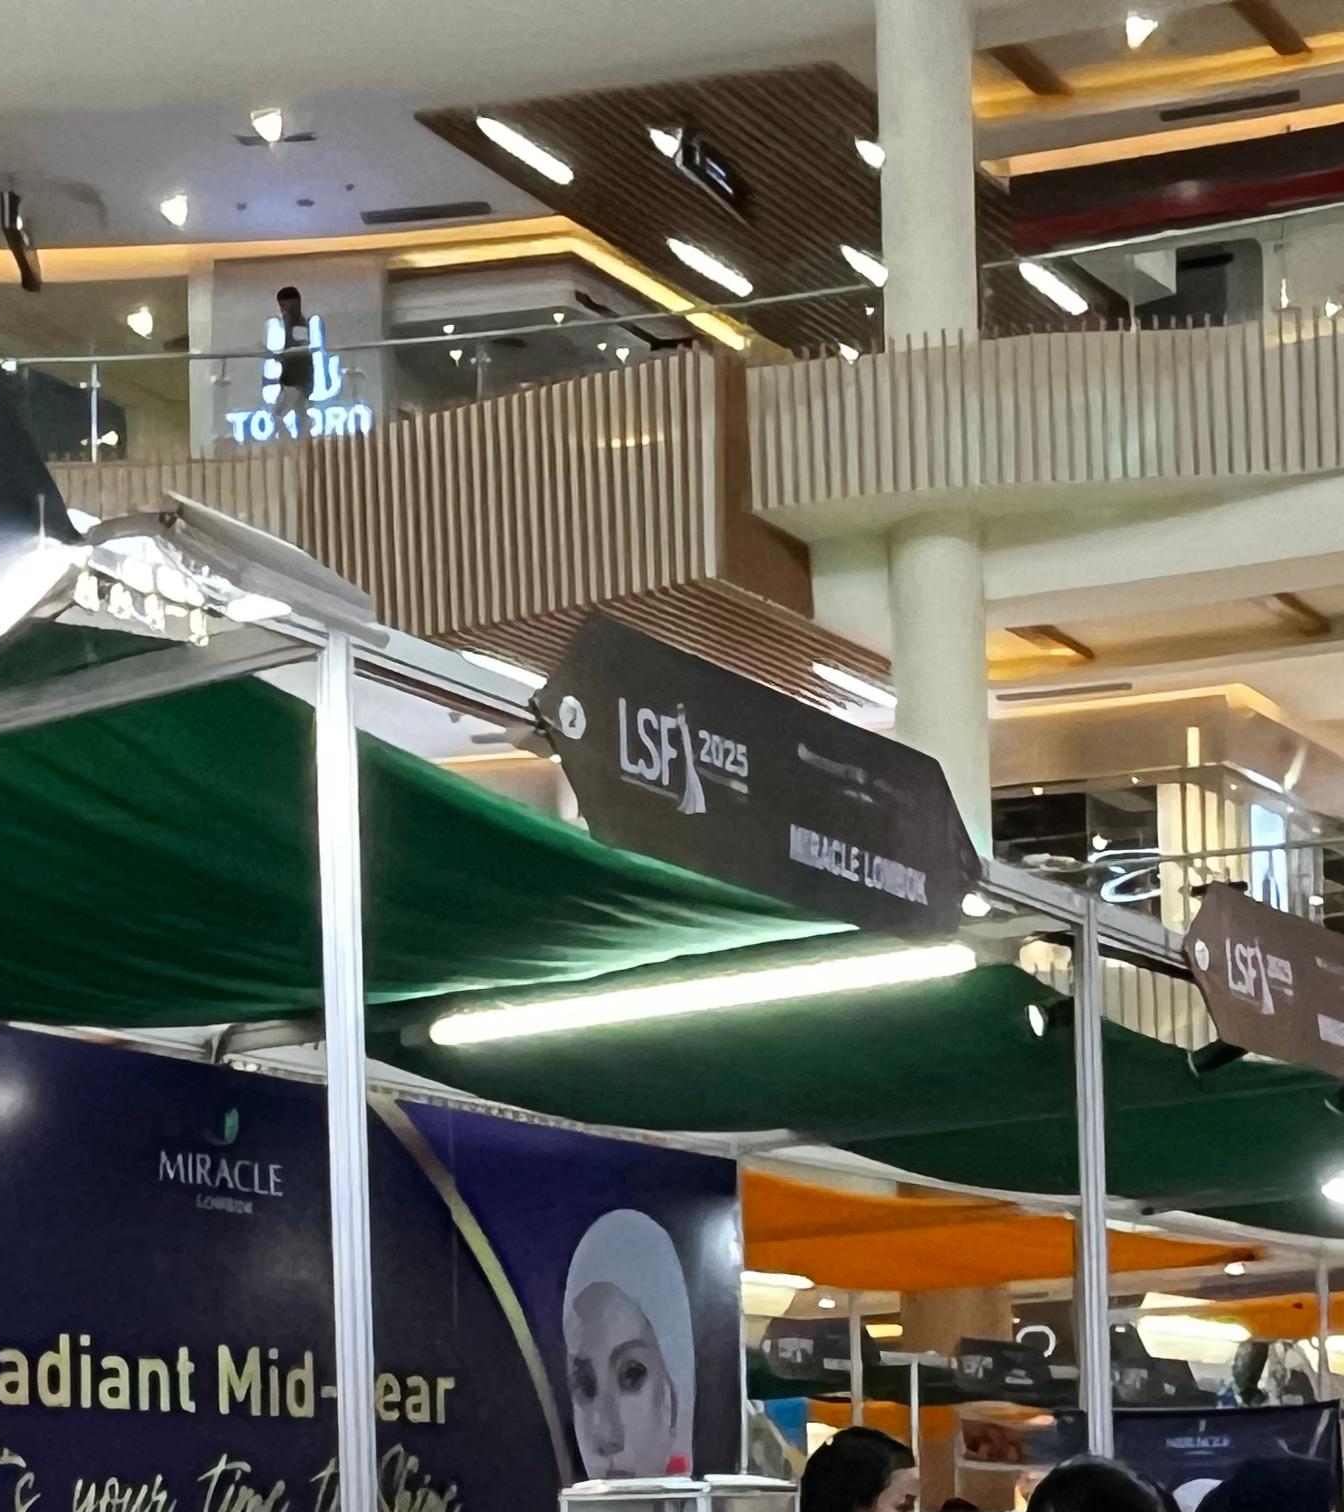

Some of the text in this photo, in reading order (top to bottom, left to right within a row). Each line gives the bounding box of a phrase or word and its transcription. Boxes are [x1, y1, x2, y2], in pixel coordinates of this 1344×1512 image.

[618, 697, 678, 785] LSF
[699, 730, 748, 777] 2025
[159, 1151, 284, 1198] MIRACLE
[218, 1344, 455, 1425] Mid-ear
